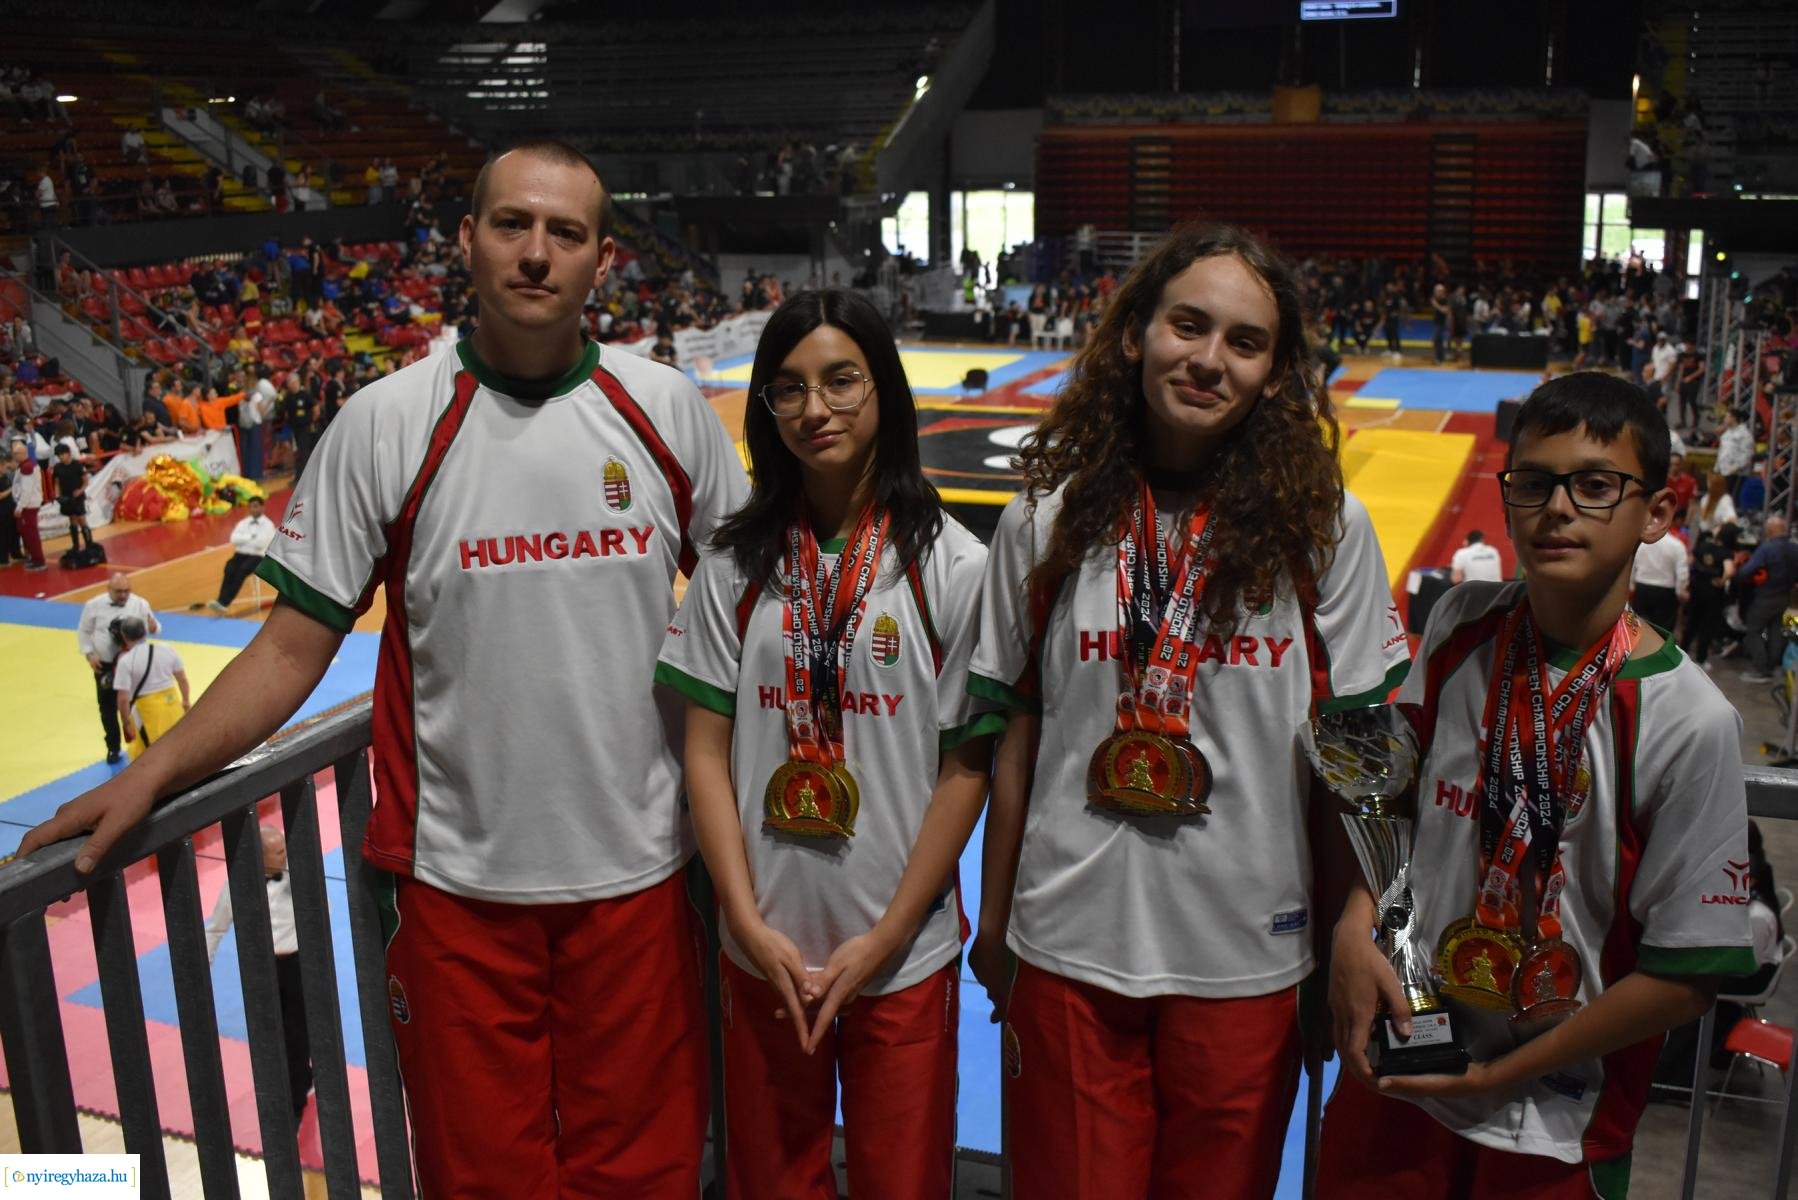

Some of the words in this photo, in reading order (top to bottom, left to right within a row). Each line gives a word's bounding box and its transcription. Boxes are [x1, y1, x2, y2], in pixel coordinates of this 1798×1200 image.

[459, 524, 655, 570] HUNGARY
[792, 524, 801, 598] CHAMPIONSHI
[866, 535, 878, 565] OPEN
[793, 600, 802, 630] OPEN
[1141, 592, 1151, 622] 2024
[1168, 597, 1189, 637] WORLD
[1183, 565, 1201, 597] OPEN
[794, 631, 804, 670] WORLD
[1529, 656, 1541, 691] OPEN
[1568, 661, 1598, 694] OPEN
[1490, 679, 1513, 774] CHAMPIONSHIP
[1532, 694, 1550, 789] CHAMPIONSHIP
[1489, 776, 1500, 809] 2024
[1539, 792, 1552, 826] 2024
